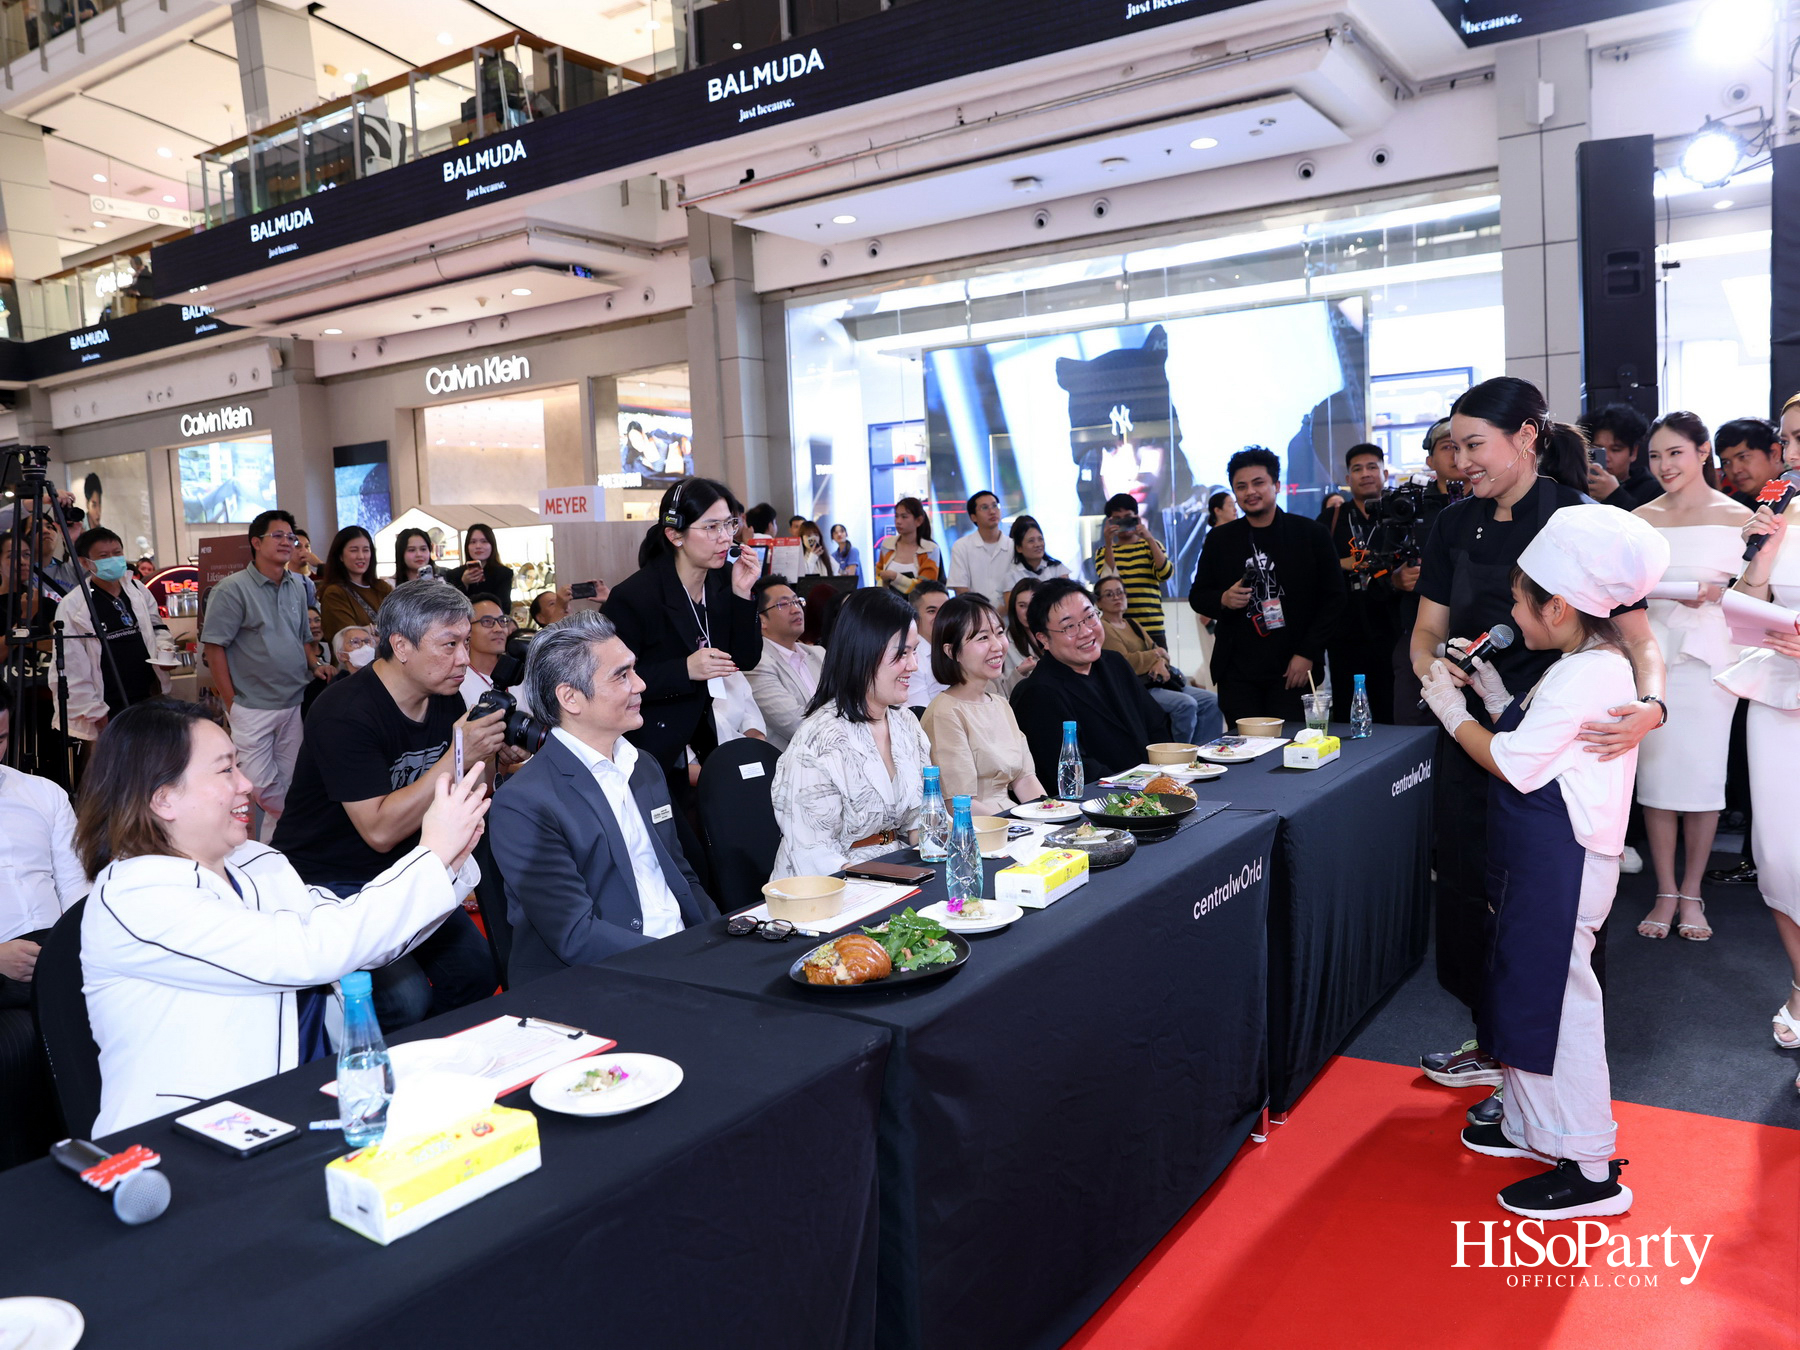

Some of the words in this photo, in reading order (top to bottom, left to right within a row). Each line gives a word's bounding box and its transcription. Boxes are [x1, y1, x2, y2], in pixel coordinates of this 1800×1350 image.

[1125, 0, 1151, 20] just
[708, 48, 825, 103] BALMUDA
[738, 106, 756, 123] just
[443, 139, 527, 183] BALMUDA
[250, 207, 314, 243] BALMUDA
[69, 328, 110, 351] BALMUDA
[425, 363, 484, 395] Calvin
[484, 354, 530, 385] Klein
[180, 411, 221, 437] Calvin
[220, 405, 253, 430] Klein
[545, 496, 587, 515] MEYER
